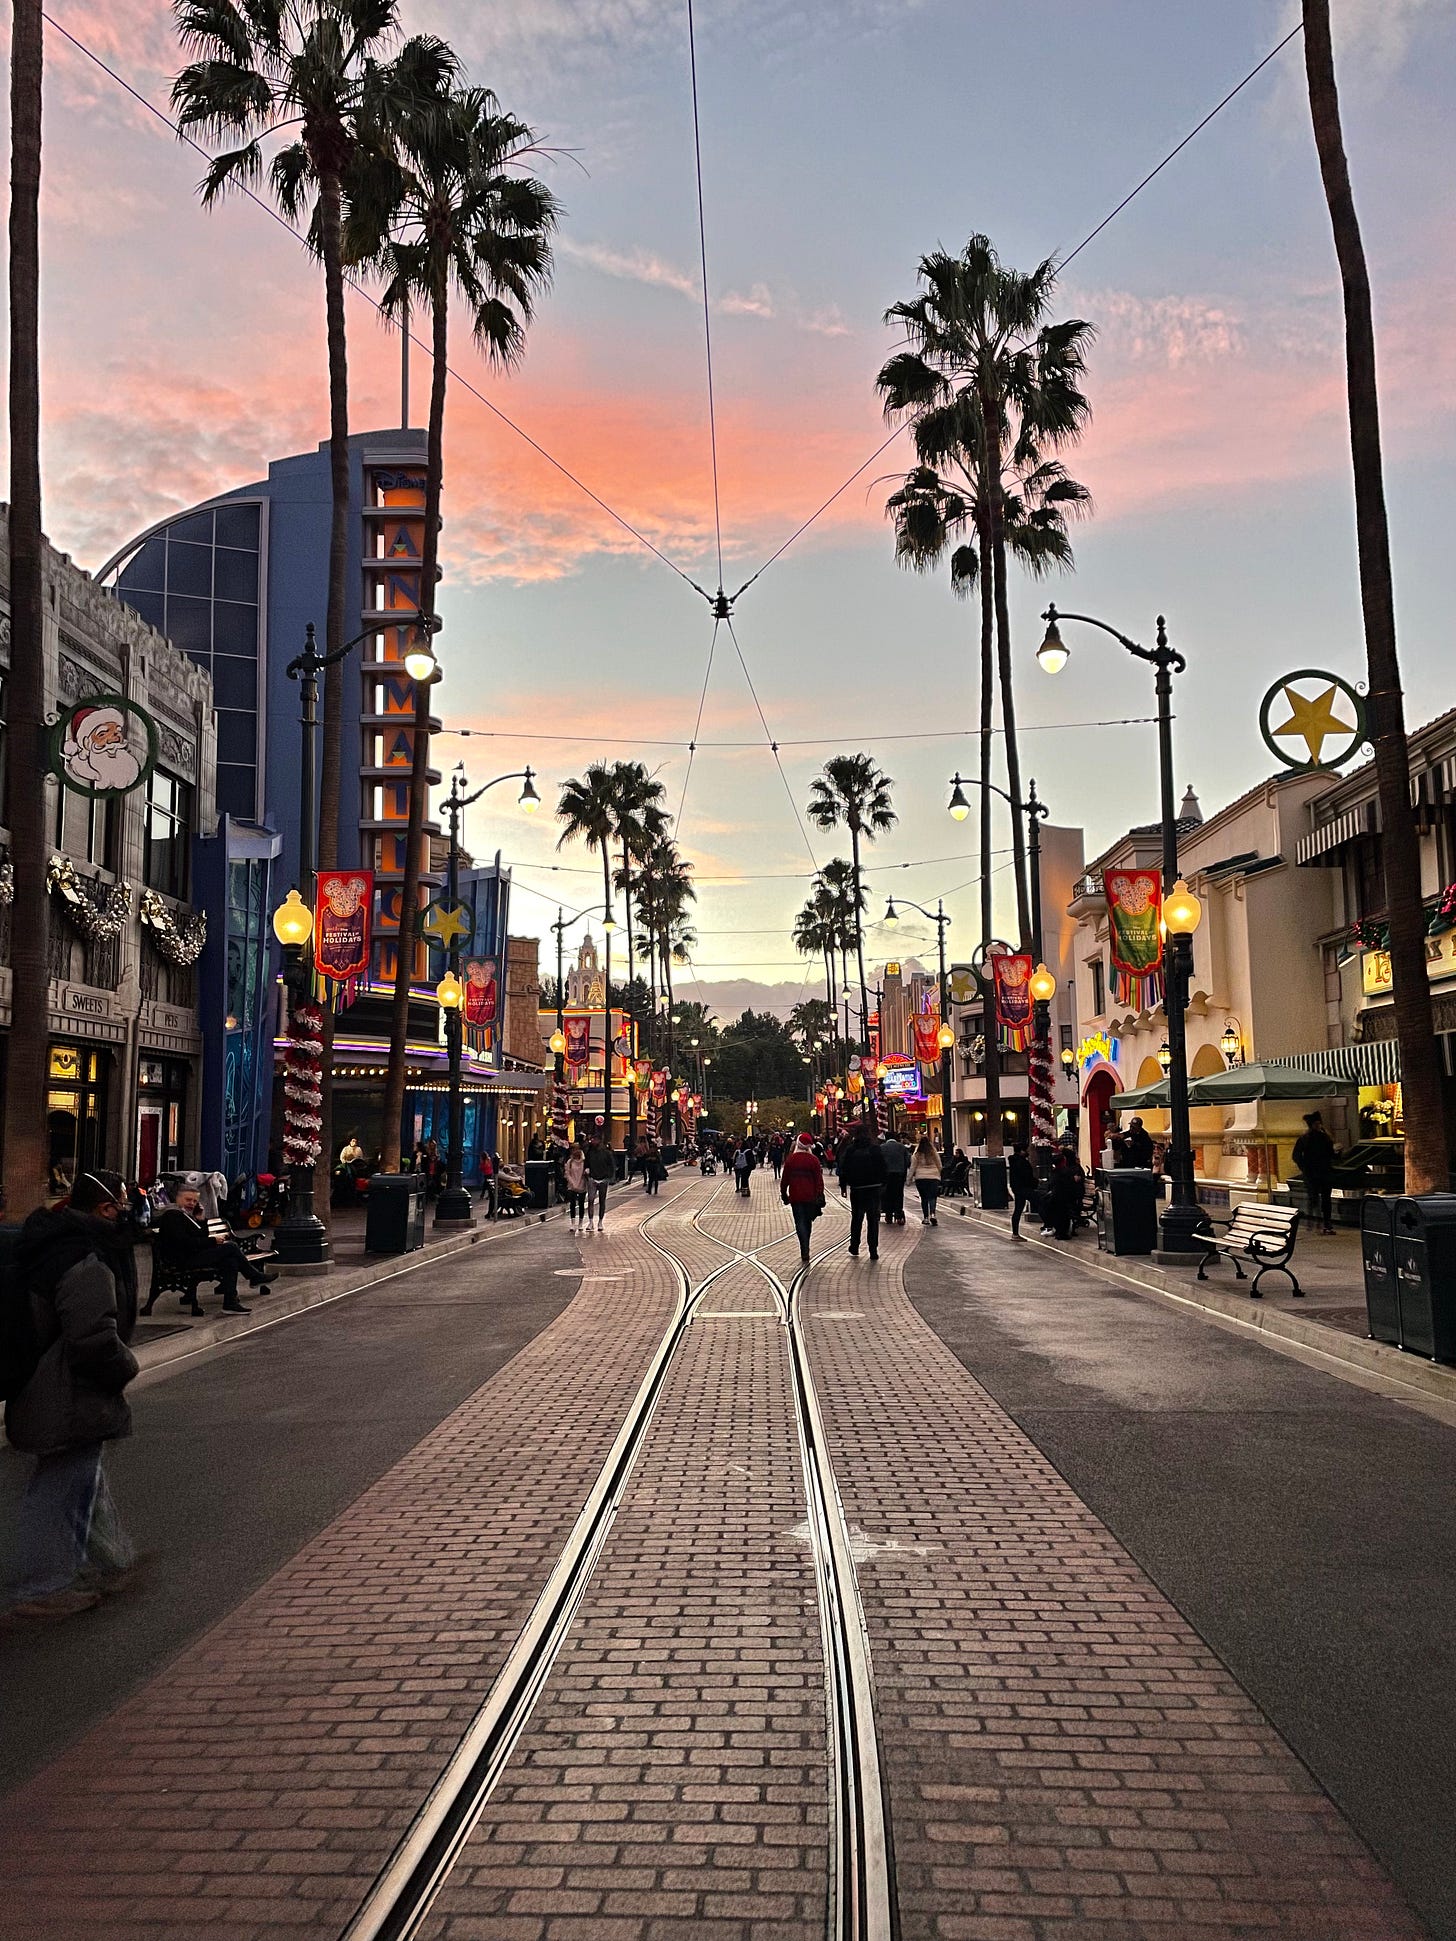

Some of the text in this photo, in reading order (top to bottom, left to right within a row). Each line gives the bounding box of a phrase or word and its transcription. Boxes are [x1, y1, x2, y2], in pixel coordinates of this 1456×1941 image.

[323, 935, 362, 944] HOLIDAYS
[72, 994, 103, 1015] SWEETS
[164, 1013, 178, 1028] PETS
